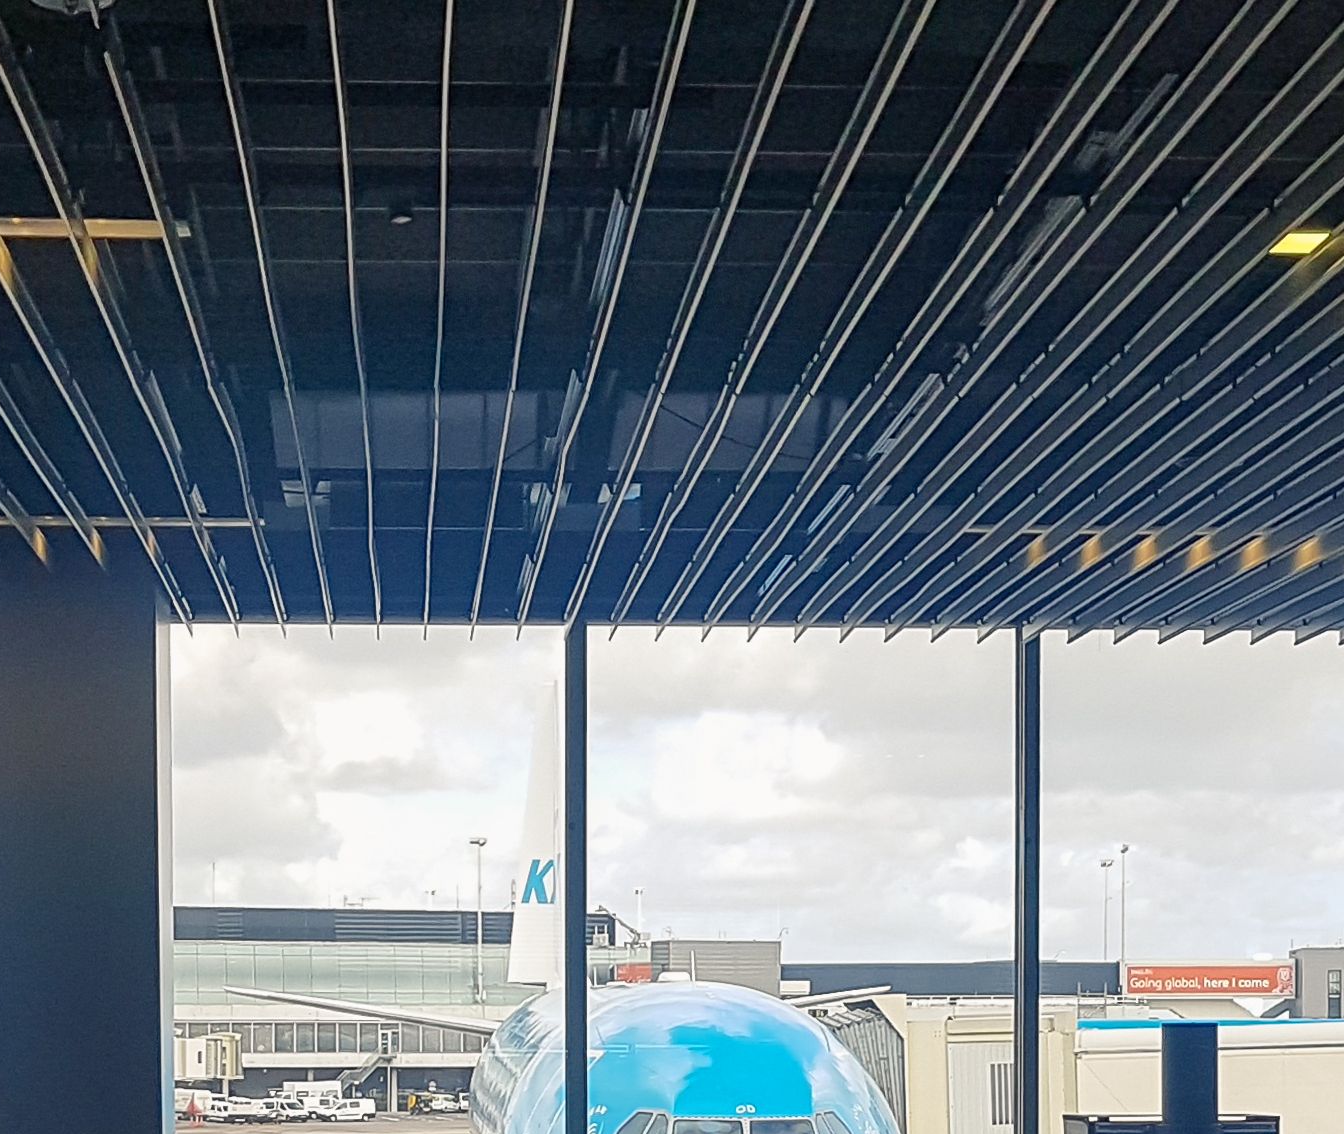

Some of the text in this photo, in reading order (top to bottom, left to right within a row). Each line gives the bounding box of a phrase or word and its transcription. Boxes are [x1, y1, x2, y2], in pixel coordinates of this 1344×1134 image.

[1130, 977, 1269, 991] Going global, here I come
